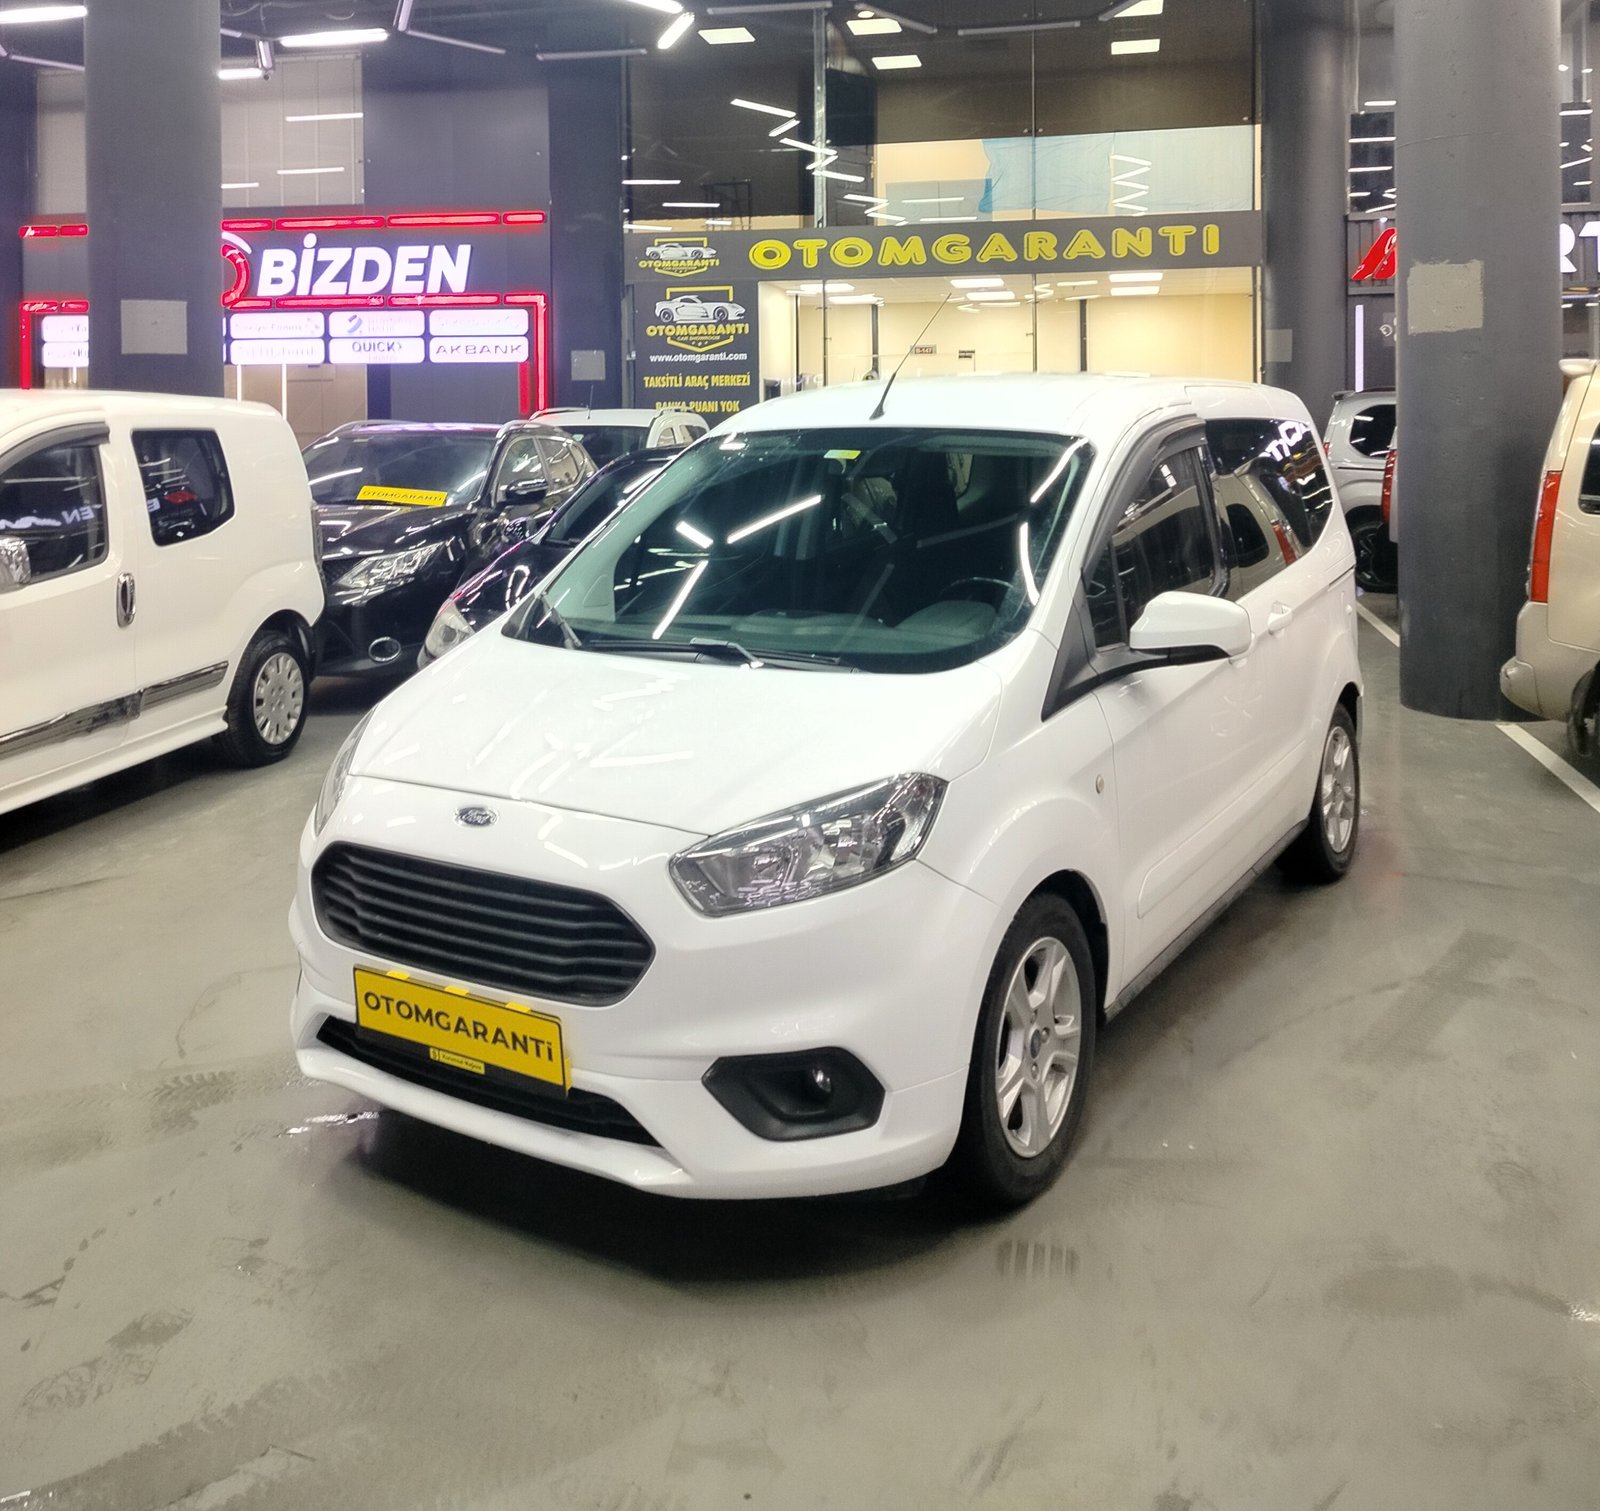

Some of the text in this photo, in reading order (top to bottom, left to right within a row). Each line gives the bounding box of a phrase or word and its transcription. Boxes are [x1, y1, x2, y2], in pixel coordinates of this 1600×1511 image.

[748, 224, 1221, 270] OTOMGARANTI
[257, 233, 472, 297] BİZDEN
[638, 258, 720, 269] OTOMGARANTI
[646, 322, 750, 337] OTOMGARANTI
[352, 341, 396, 354] QUICK
[435, 344, 522, 355] AKBANK
[649, 351, 748, 363] www.otomgaranti.com
[643, 371, 751, 390] TAKSİTLİ ARAÇ MERKEZİ
[690, 400, 718, 413] PUANI
[720, 399, 740, 413] YOK
